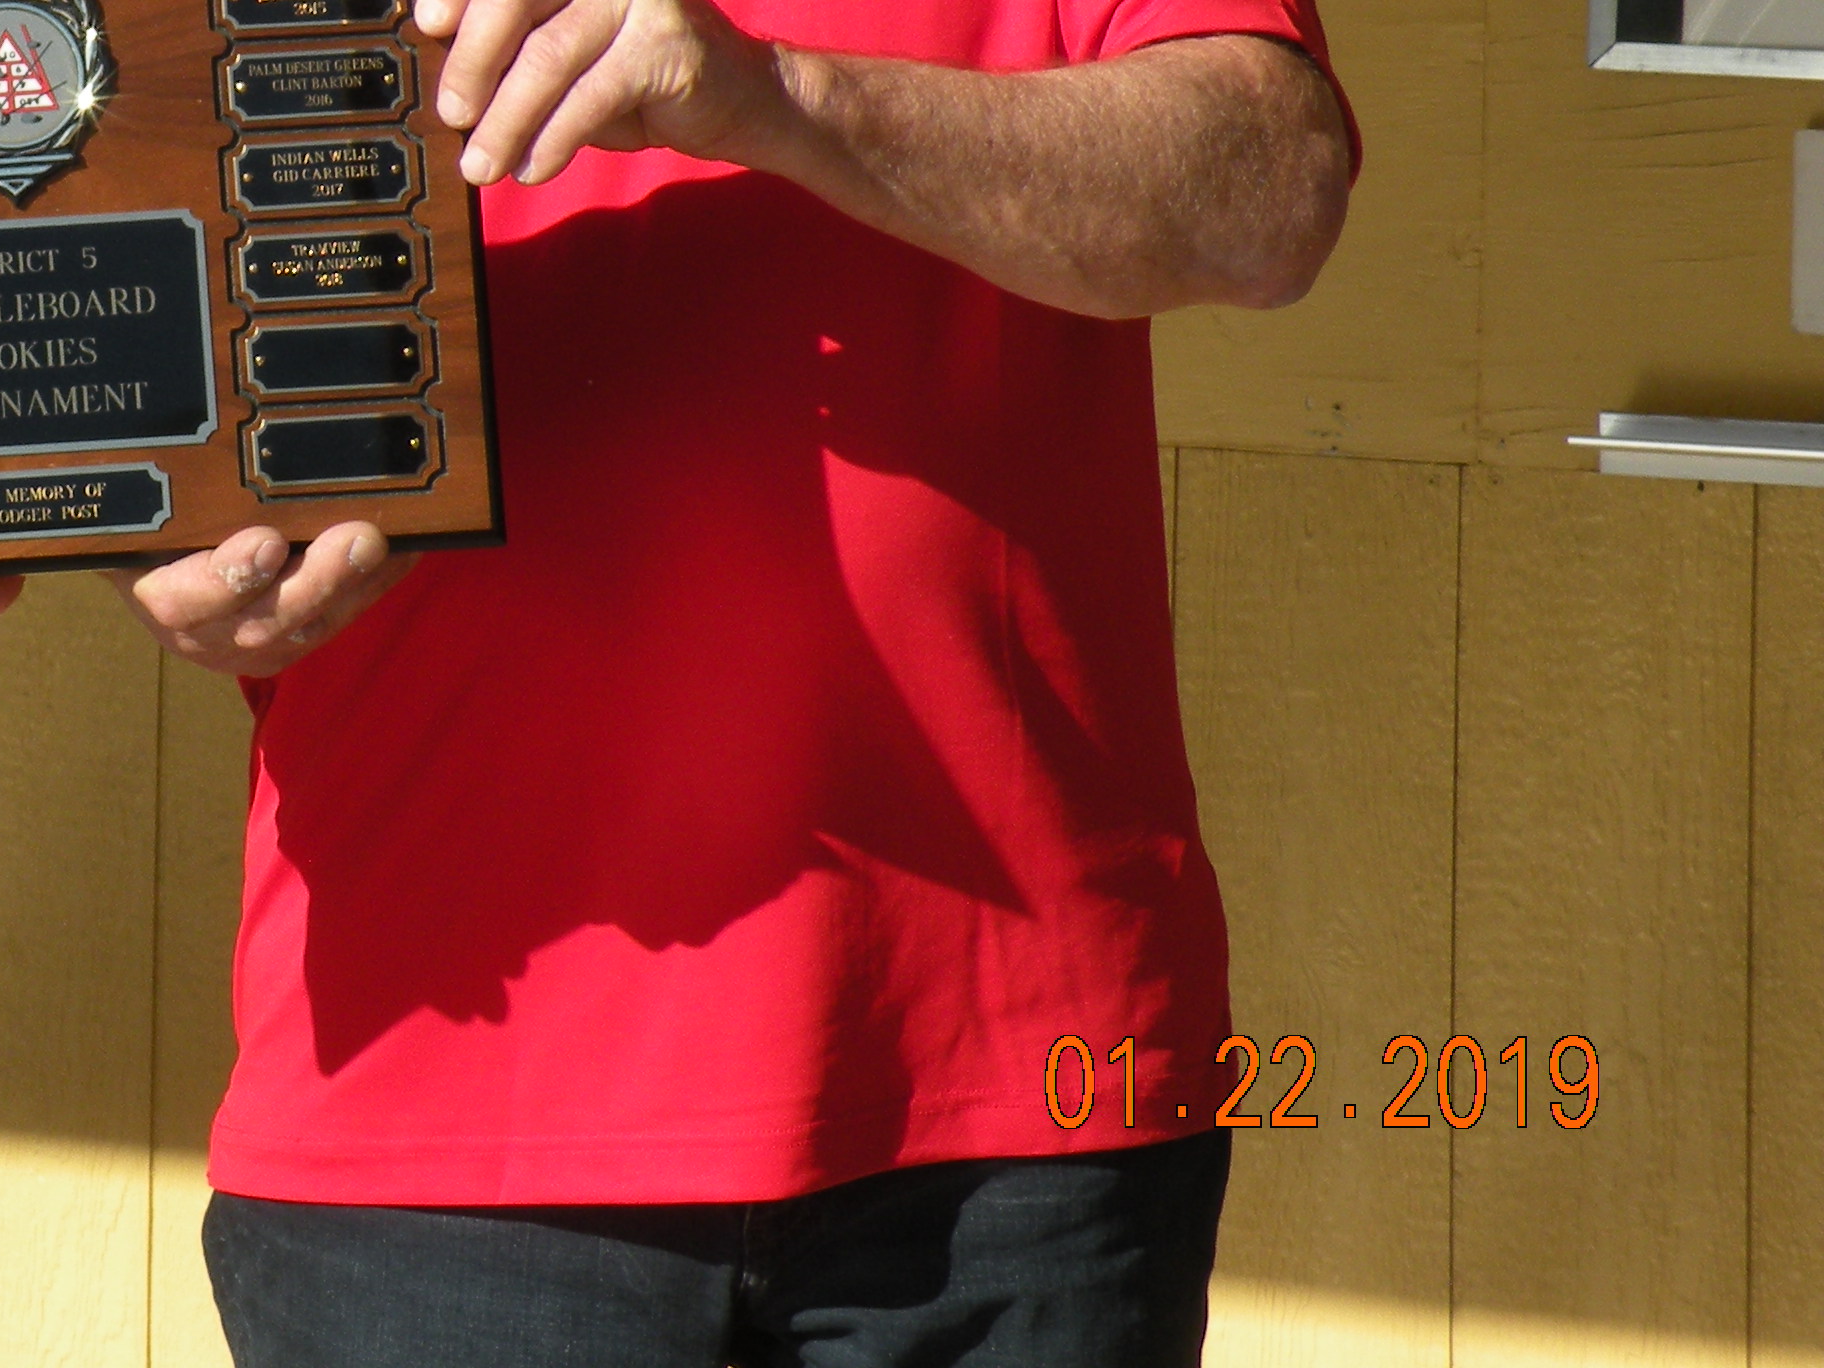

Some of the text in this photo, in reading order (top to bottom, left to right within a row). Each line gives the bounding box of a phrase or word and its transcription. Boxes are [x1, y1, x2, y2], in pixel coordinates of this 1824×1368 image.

[248, 56, 385, 77] PALM DESERT GREENS
[272, 74, 363, 92] CLINT BARTON
[304, 93, 334, 107] 2016
[271, 146, 380, 167] INDIAN WELLS
[272, 163, 380, 183] GID CARRIERE
[311, 182, 344, 198] 2017
[81, 245, 98, 269] 5
[5, 483, 77, 502] MEMORY
[84, 481, 107, 498] OF
[60, 502, 102, 520] POST
